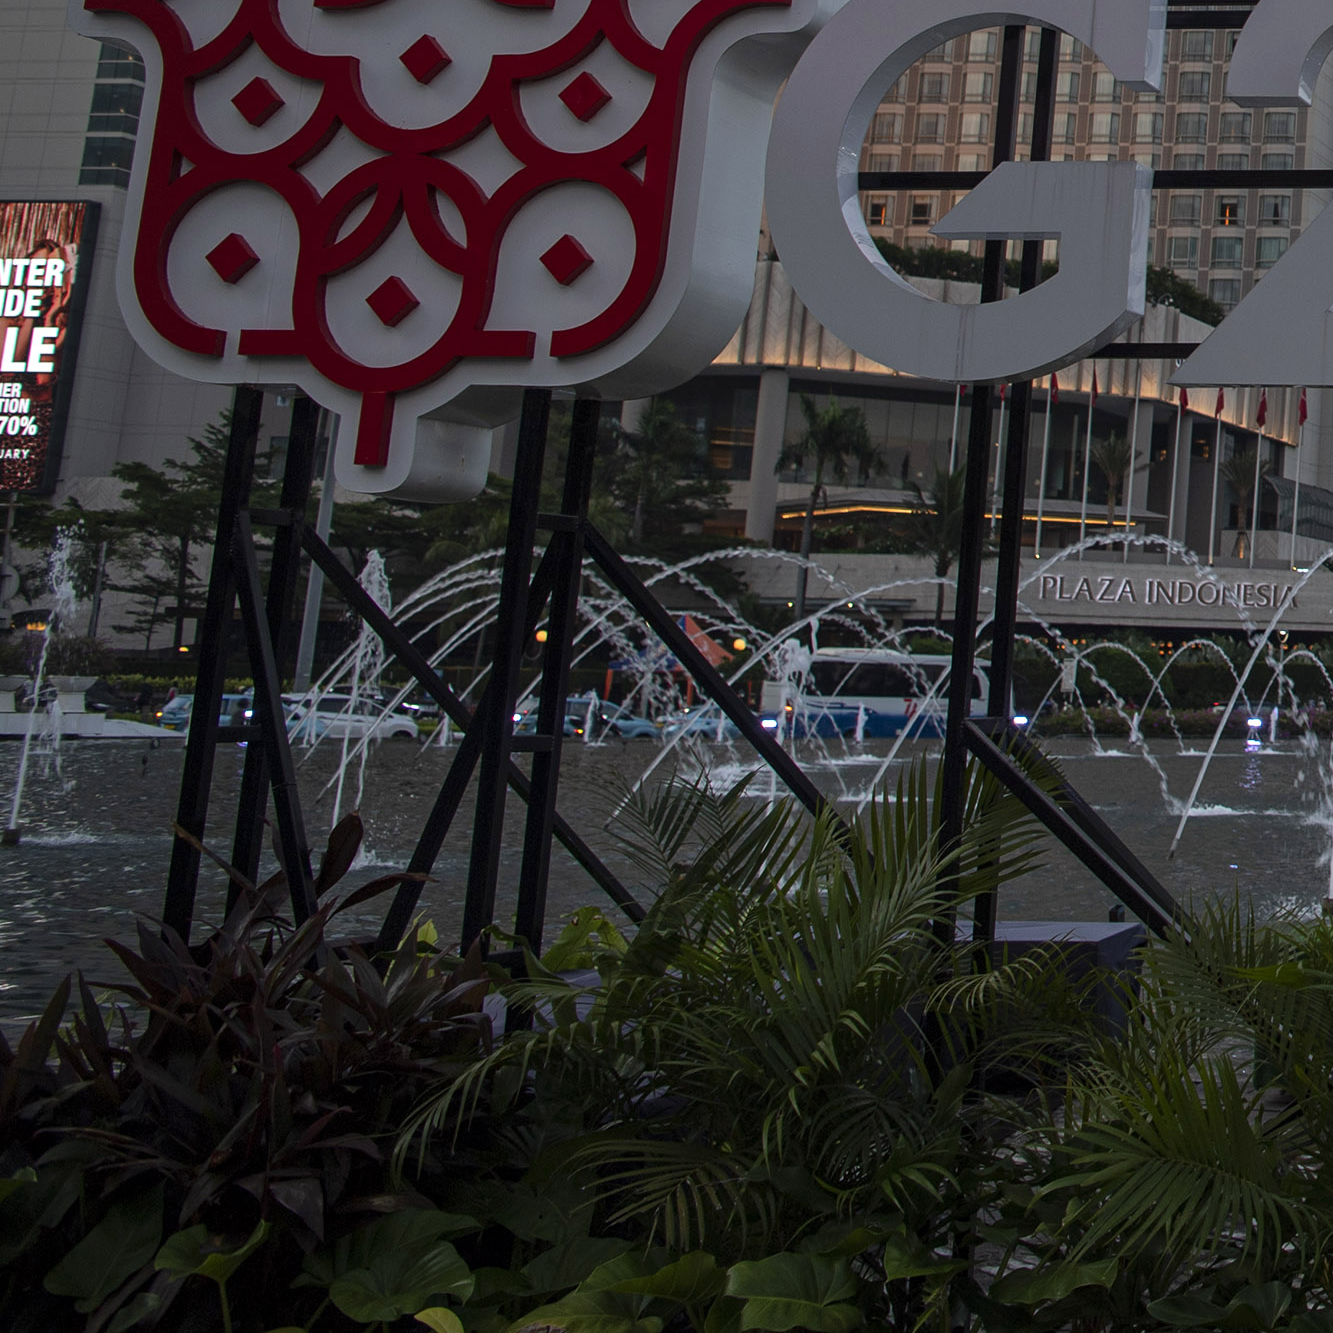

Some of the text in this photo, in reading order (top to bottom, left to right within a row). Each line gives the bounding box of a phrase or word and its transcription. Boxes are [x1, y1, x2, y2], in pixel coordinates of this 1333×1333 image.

[0, 326, 60, 373] LE
[0, 415, 39, 436] 70%
[1040, 574, 1299, 608] PLAZA INDONESIA
